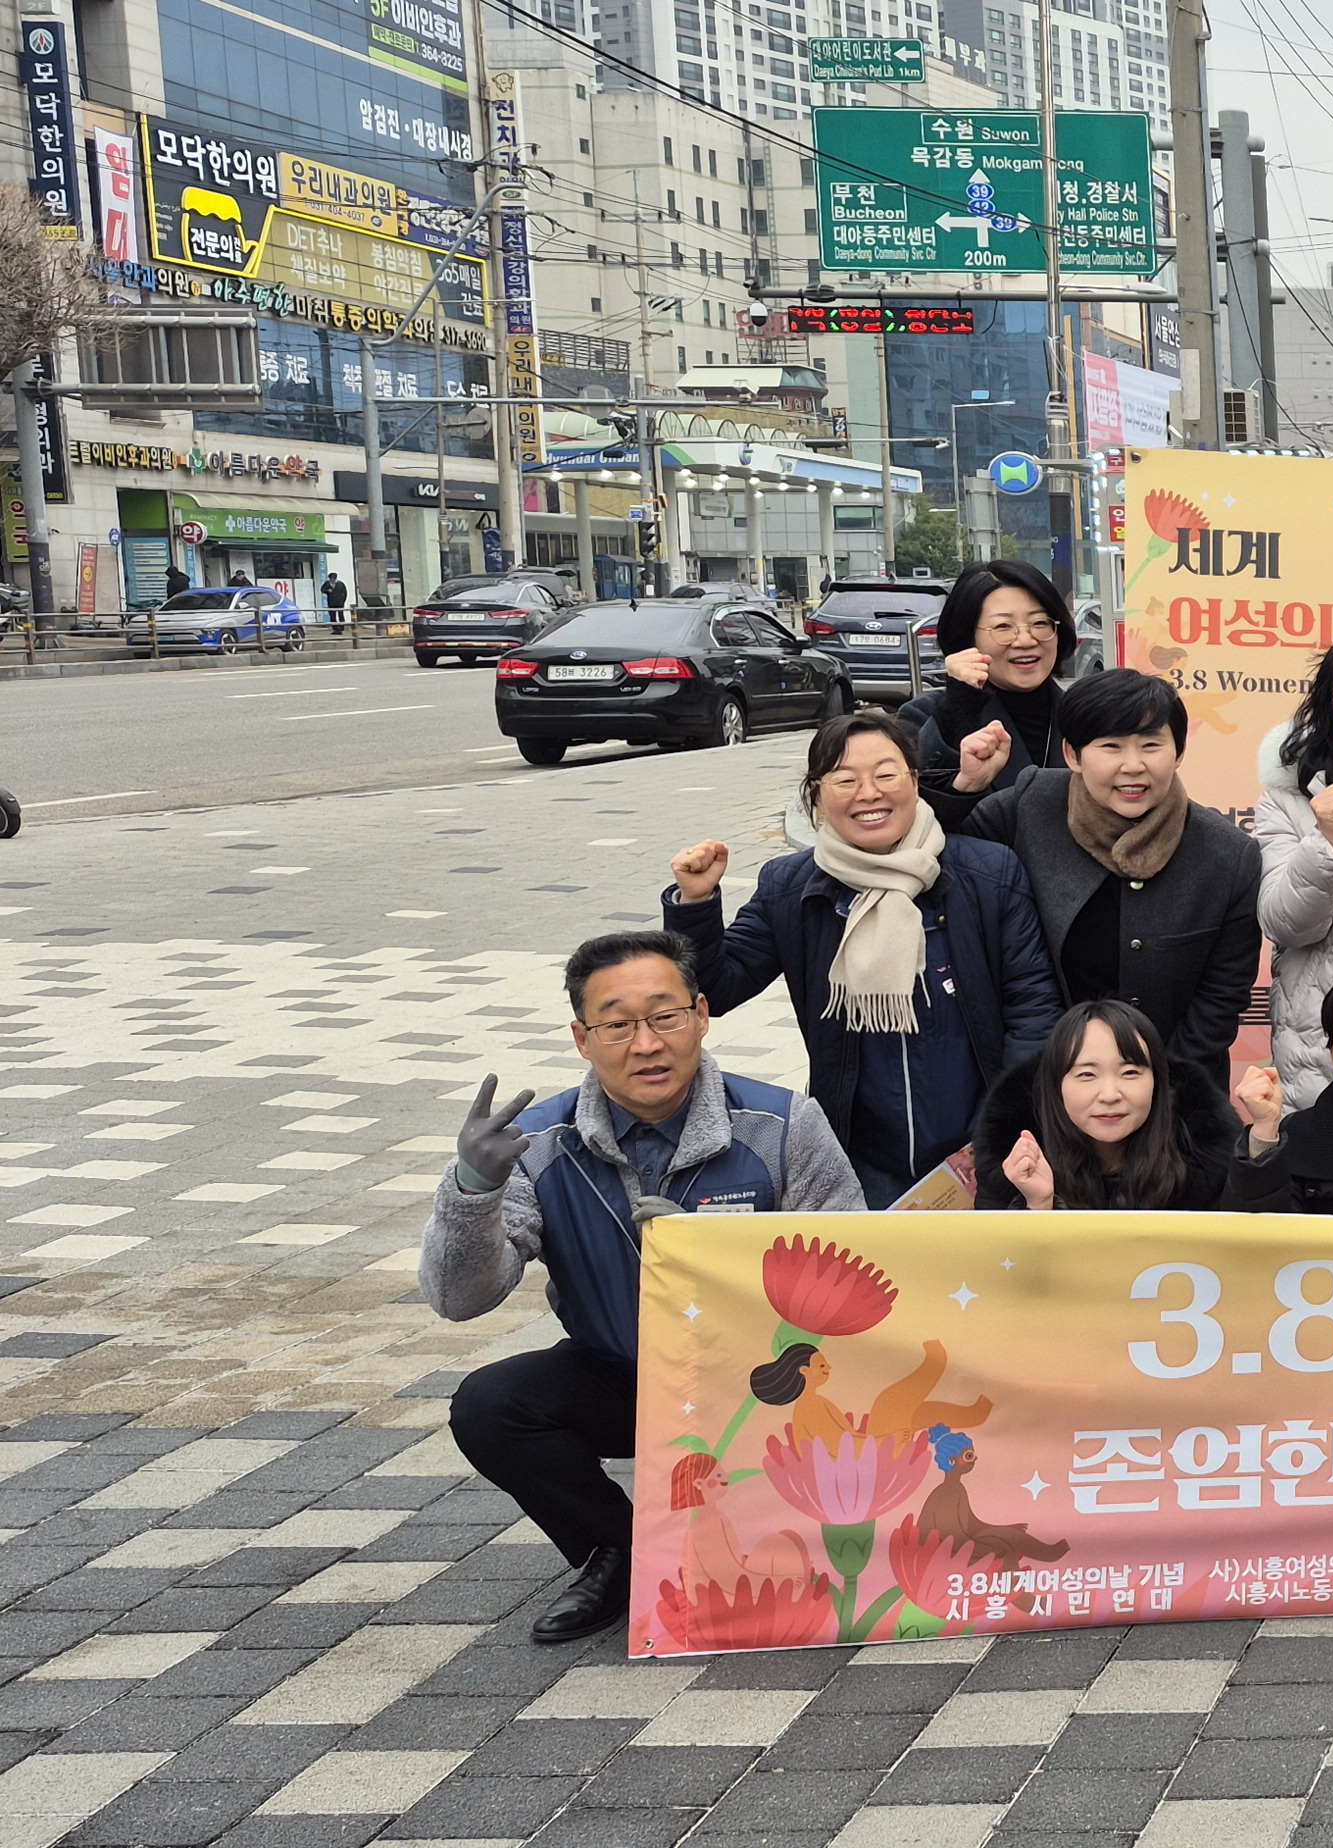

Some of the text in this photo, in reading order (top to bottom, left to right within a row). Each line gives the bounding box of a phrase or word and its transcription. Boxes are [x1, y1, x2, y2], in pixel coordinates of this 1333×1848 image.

[27, 2, 47, 11] 2F
[391, 0, 461, 49] 이비인후과
[421, 43, 462, 72] 364-8225
[944, 36, 986, 73] 피부과
[899, 67, 920, 77] 1km
[32, 62, 69, 216] 모닥한의원
[359, 99, 473, 160] 암검진 대장내시경
[931, 118, 1030, 141] 수원 Suwon
[156, 129, 277, 199] 모닥한의원
[911, 147, 974, 169] 목감동
[104, 142, 131, 262] 임대
[291, 160, 392, 216] 우리내과의원
[833, 184, 876, 204] 부천
[972, 185, 988, 198] 39
[328, 205, 366, 222] 404-4037
[834, 206, 905, 219] Bucheon
[1068, 207, 1139, 222] Hall Police Stn
[190, 228, 234, 261] 전문의
[833, 225, 937, 247] 대야동주민센터
[291, 256, 347, 290] 체질보약
[371, 242, 422, 276] 봉침약침
[964, 251, 1007, 267] 200m
[461, 292, 484, 317] 진료
[208, 451, 322, 484] 아름다운약국
[181, 514, 305, 542] 약 아름다운약국 약
[1168, 527, 1282, 579] 세계
[1166, 596, 1333, 650] 여성의
[579, 667, 607, 678] 3226
[1169, 668, 1207, 691] 3.8
[946, 1561, 1186, 1598] 3.8세계여성의날 기념
